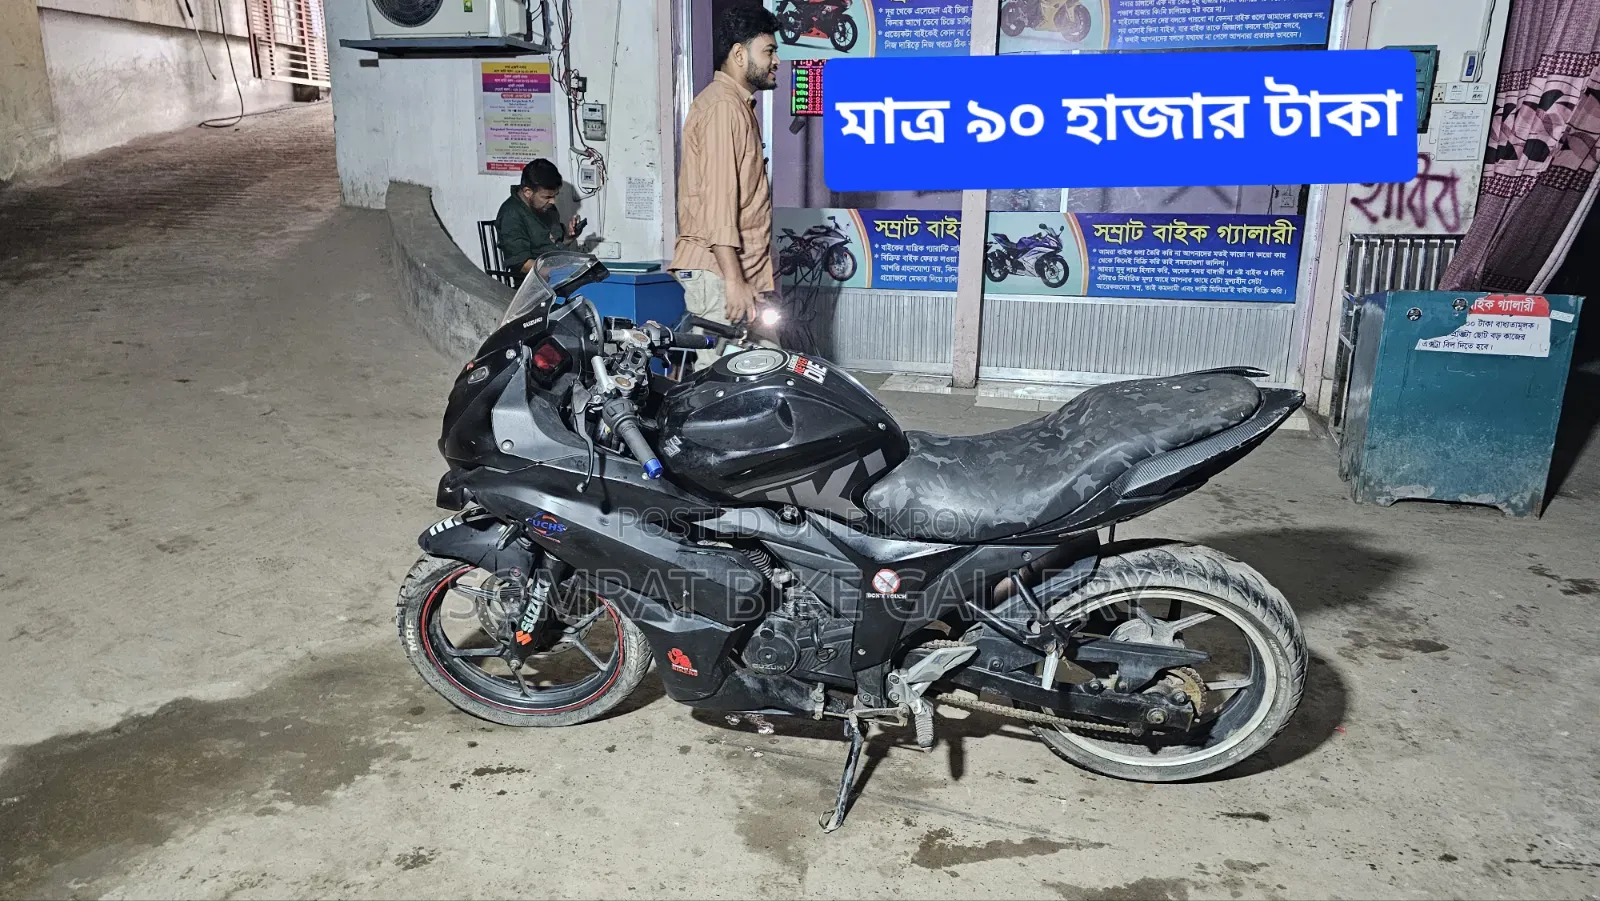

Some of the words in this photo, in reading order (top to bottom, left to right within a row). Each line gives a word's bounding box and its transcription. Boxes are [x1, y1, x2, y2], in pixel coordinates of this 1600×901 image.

[874, 214, 922, 240] সম্রাট
[926, 215, 961, 240] বাই
[1092, 218, 1147, 245] সম্রাট
[1151, 219, 1210, 245] বাইক
[1217, 219, 1297, 245] গ্যালারী
[1498, 298, 1536, 312] গ্যালারী
[523, 317, 543, 328] SUZUKI
[1478, 319, 1493, 328] টাকা
[1443, 340, 1455, 348] বিল
[1457, 341, 1473, 349] দিতে
[803, 360, 828, 385] DIE
[520, 578, 552, 634] SUZUKI
[405, 619, 418, 652] MRF
[752, 663, 787, 671] SUZUKI
